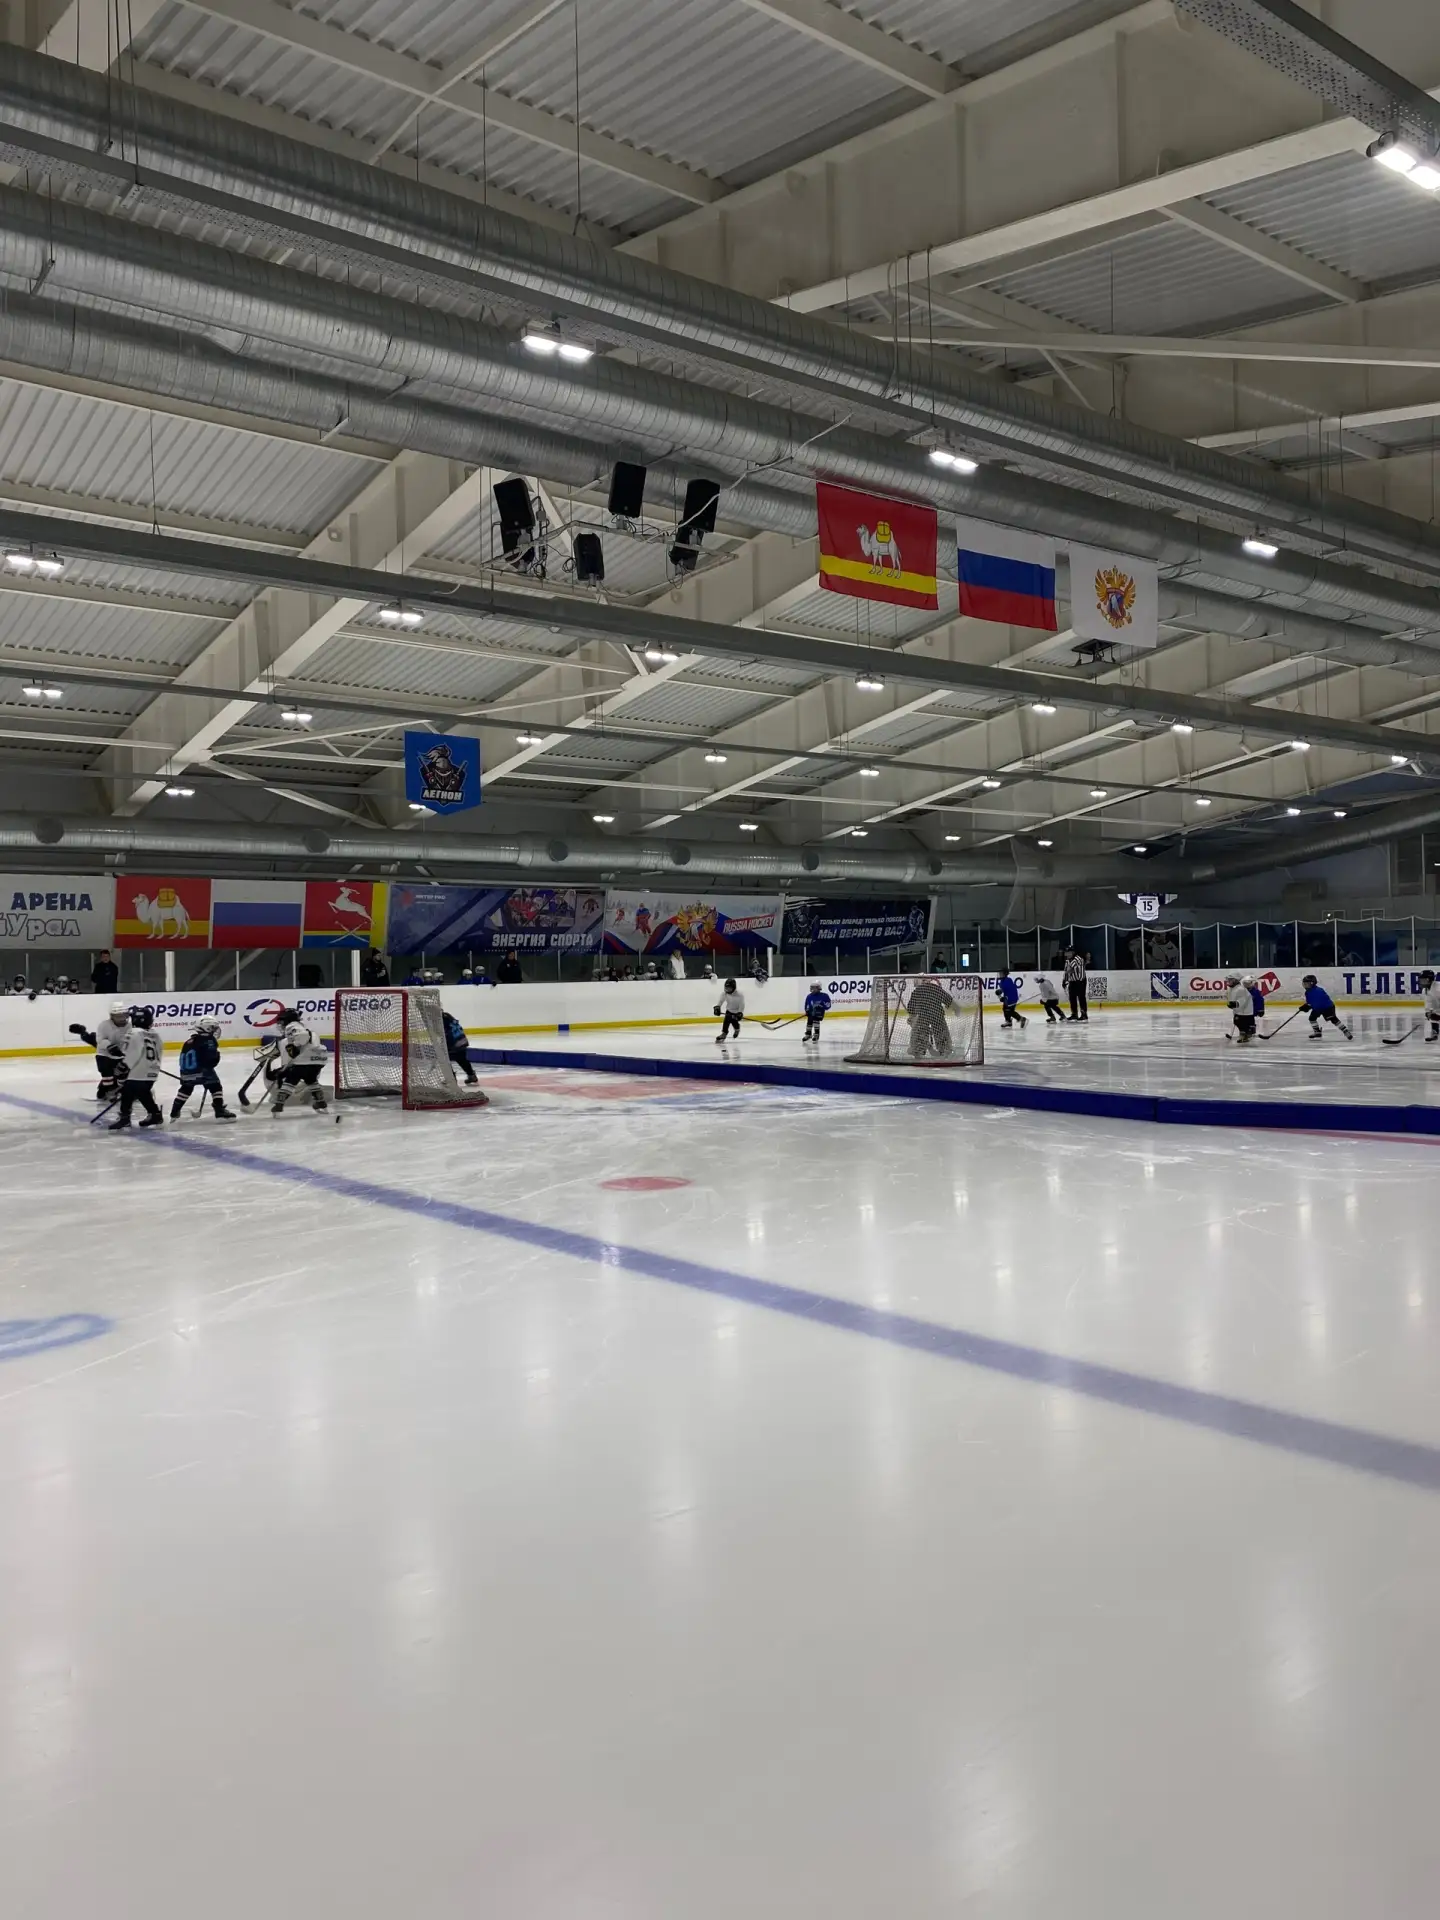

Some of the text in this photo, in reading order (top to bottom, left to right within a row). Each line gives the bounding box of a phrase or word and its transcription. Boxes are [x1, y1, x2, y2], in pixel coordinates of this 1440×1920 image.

[422, 789, 463, 801] ЛЕГИОН
[11, 892, 93, 911] АРЕНА
[1142, 901, 1153, 911] 15
[723, 916, 774, 933] RUSSIA HOCKEY
[817, 926, 906, 939] МЫ ВЕРИМ В ВАС!
[491, 933, 594, 947] ЭНЕРГИЯ СПОРТА
